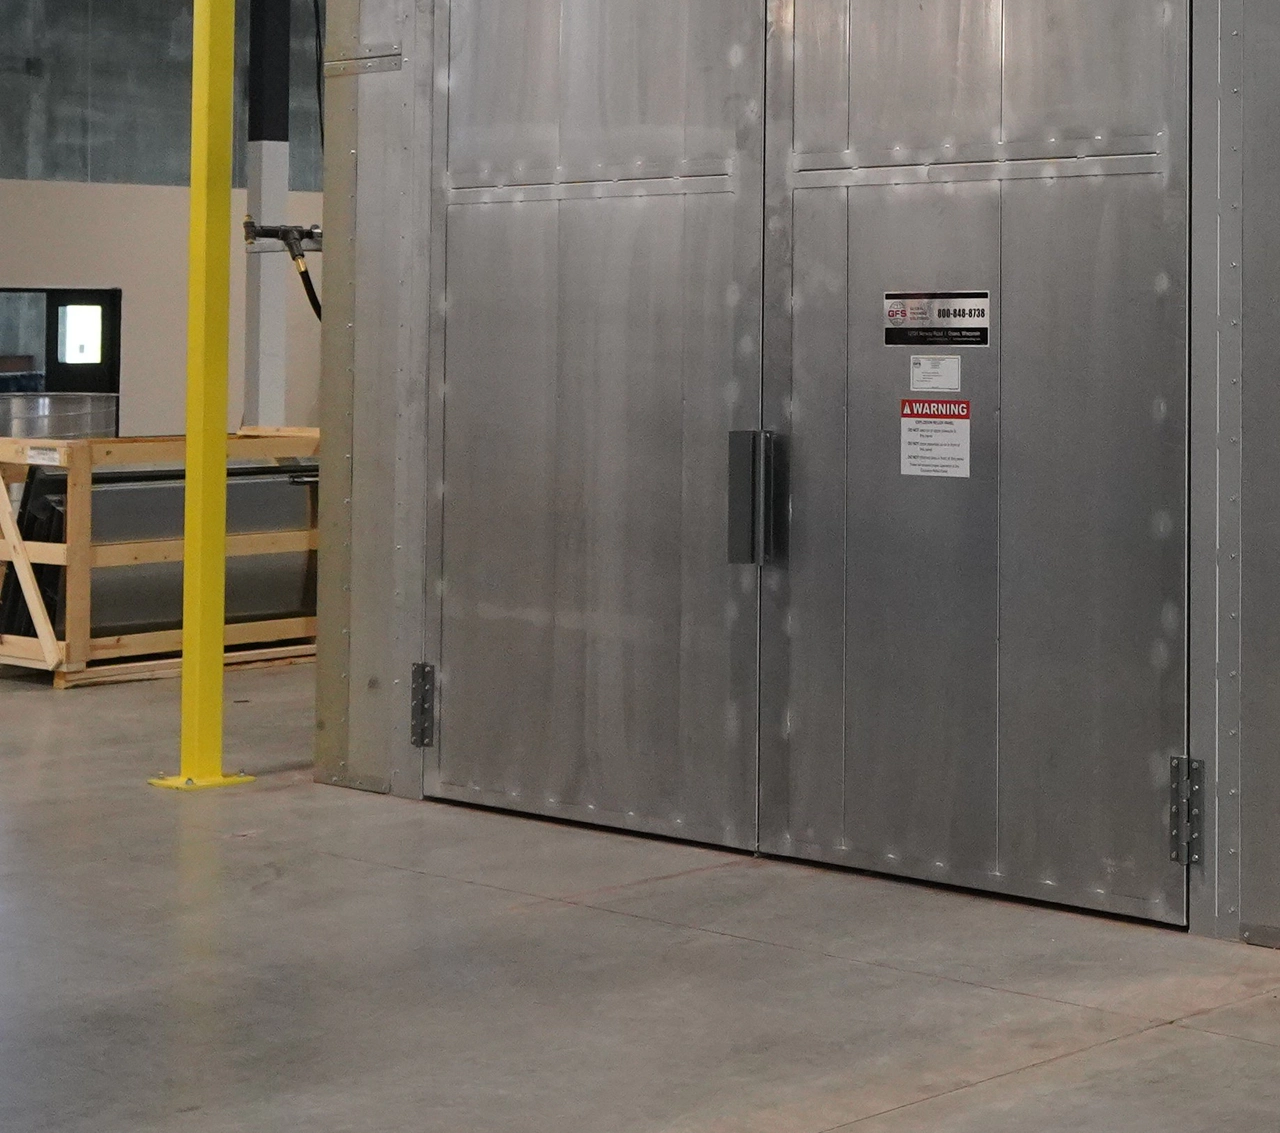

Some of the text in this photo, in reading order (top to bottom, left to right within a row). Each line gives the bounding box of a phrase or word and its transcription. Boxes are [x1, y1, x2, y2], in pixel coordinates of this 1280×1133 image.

[887, 309, 907, 318] GFS
[937, 308, 985, 318] 800-848-8738
[913, 403, 967, 415] WARNING
